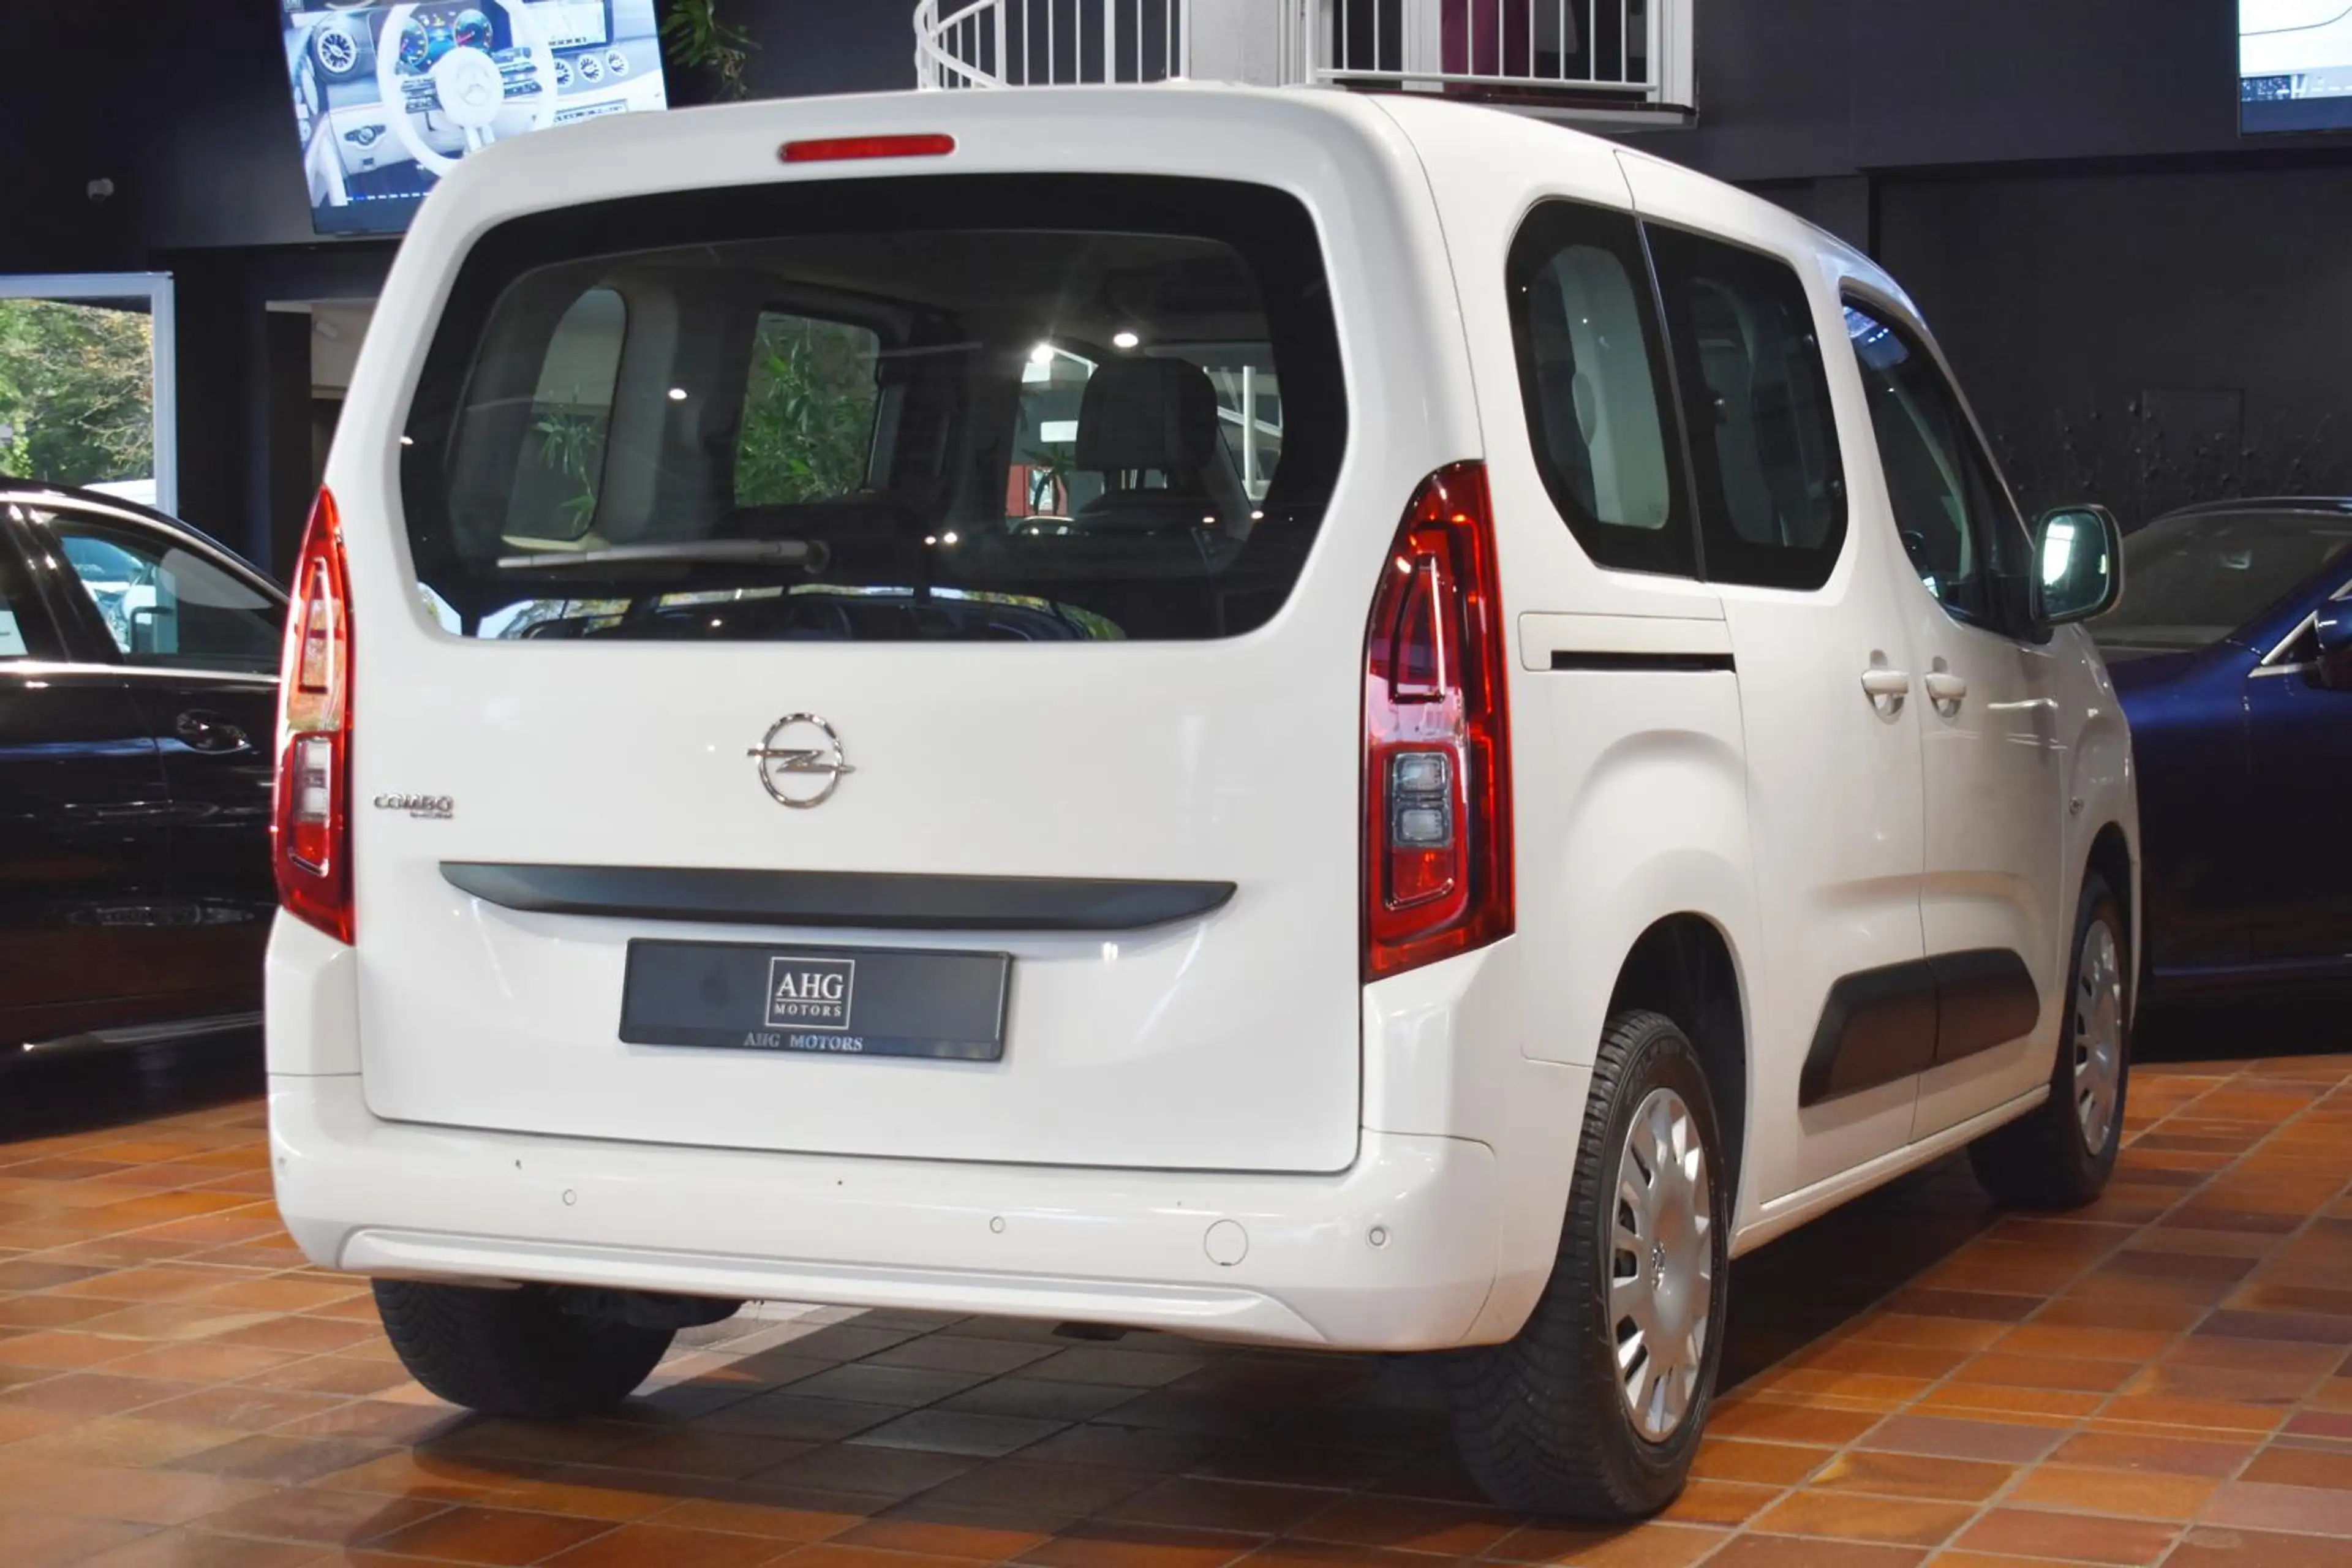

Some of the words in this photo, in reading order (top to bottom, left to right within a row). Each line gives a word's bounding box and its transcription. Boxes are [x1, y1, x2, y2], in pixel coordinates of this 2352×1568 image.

[374, 794, 454, 812] COMBO
[775, 972, 844, 999] AHG
[774, 1003, 842, 1017] MOTORS
[743, 1031, 781, 1047] AHG
[790, 1033, 864, 1052] MOTORS
